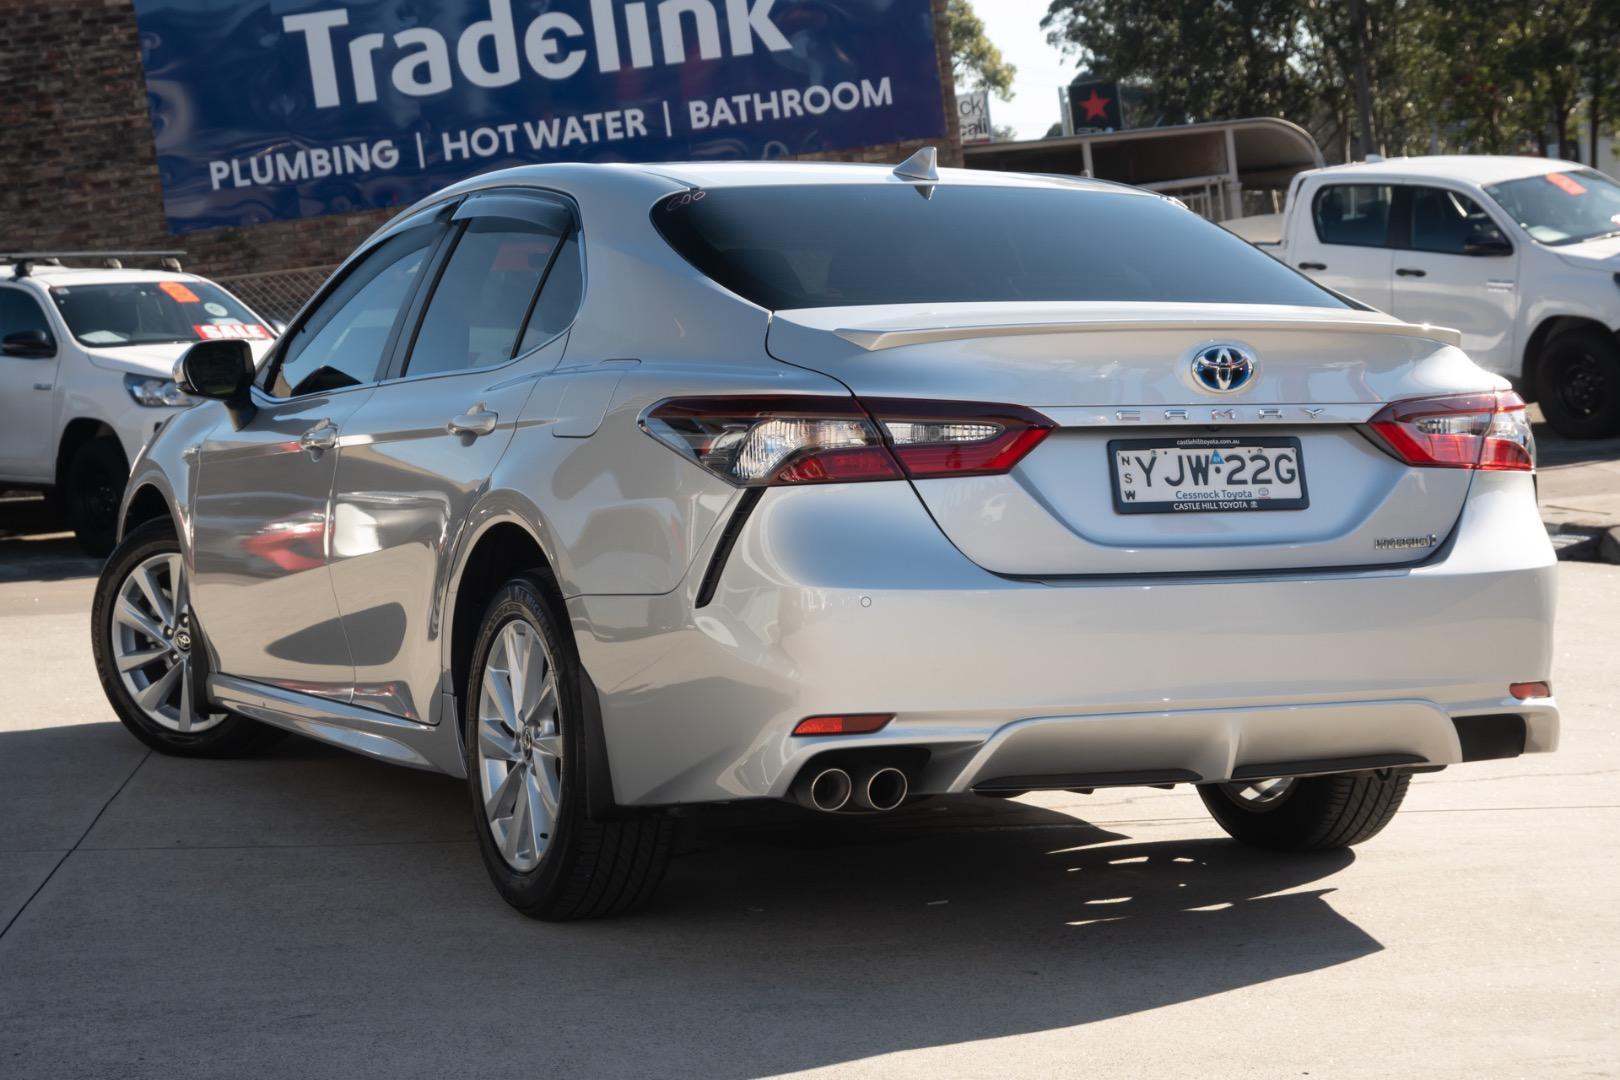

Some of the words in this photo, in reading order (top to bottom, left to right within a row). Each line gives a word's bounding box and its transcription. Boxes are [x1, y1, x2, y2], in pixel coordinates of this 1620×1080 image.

[282, 0, 793, 109] Tradelink
[209, 139, 400, 190] PLUMBING
[441, 123, 518, 162] HOT
[523, 108, 648, 150] WATER
[688, 76, 893, 130] BATHROOM
[1116, 408, 1325, 421] CAMRY
[1175, 489, 1220, 500] Cessnock
[1222, 489, 1253, 500] Toyota
[1173, 501, 1200, 510] CASTLE
[1202, 501, 1219, 510] HILL
[1219, 501, 1248, 509] TOYOTA
